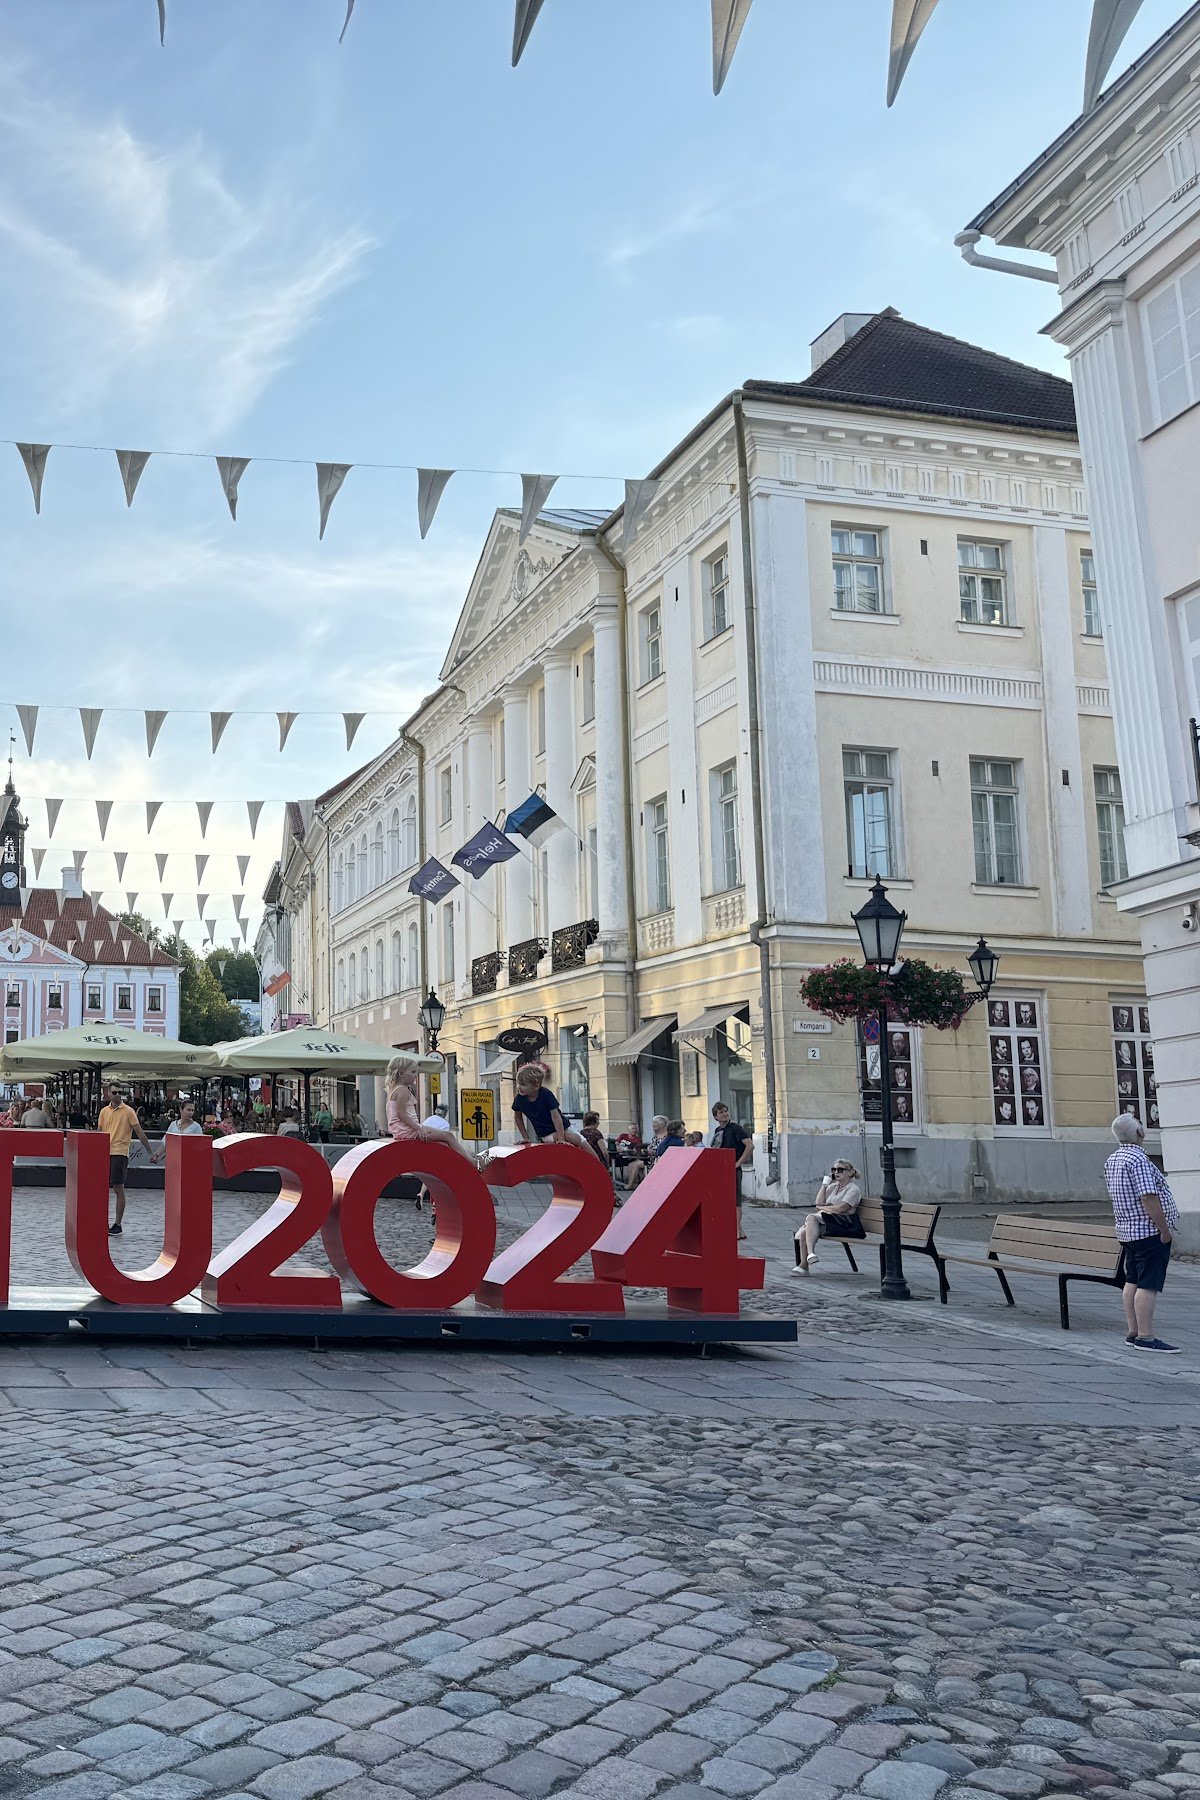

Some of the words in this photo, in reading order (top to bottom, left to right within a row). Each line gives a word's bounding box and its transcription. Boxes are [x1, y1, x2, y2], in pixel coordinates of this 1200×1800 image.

[799, 1022, 827, 1030] Kompanii
[82, 1034, 129, 1045] Leffe
[302, 1042, 350, 1053] Leffe
[811, 1049, 817, 1058] 2
